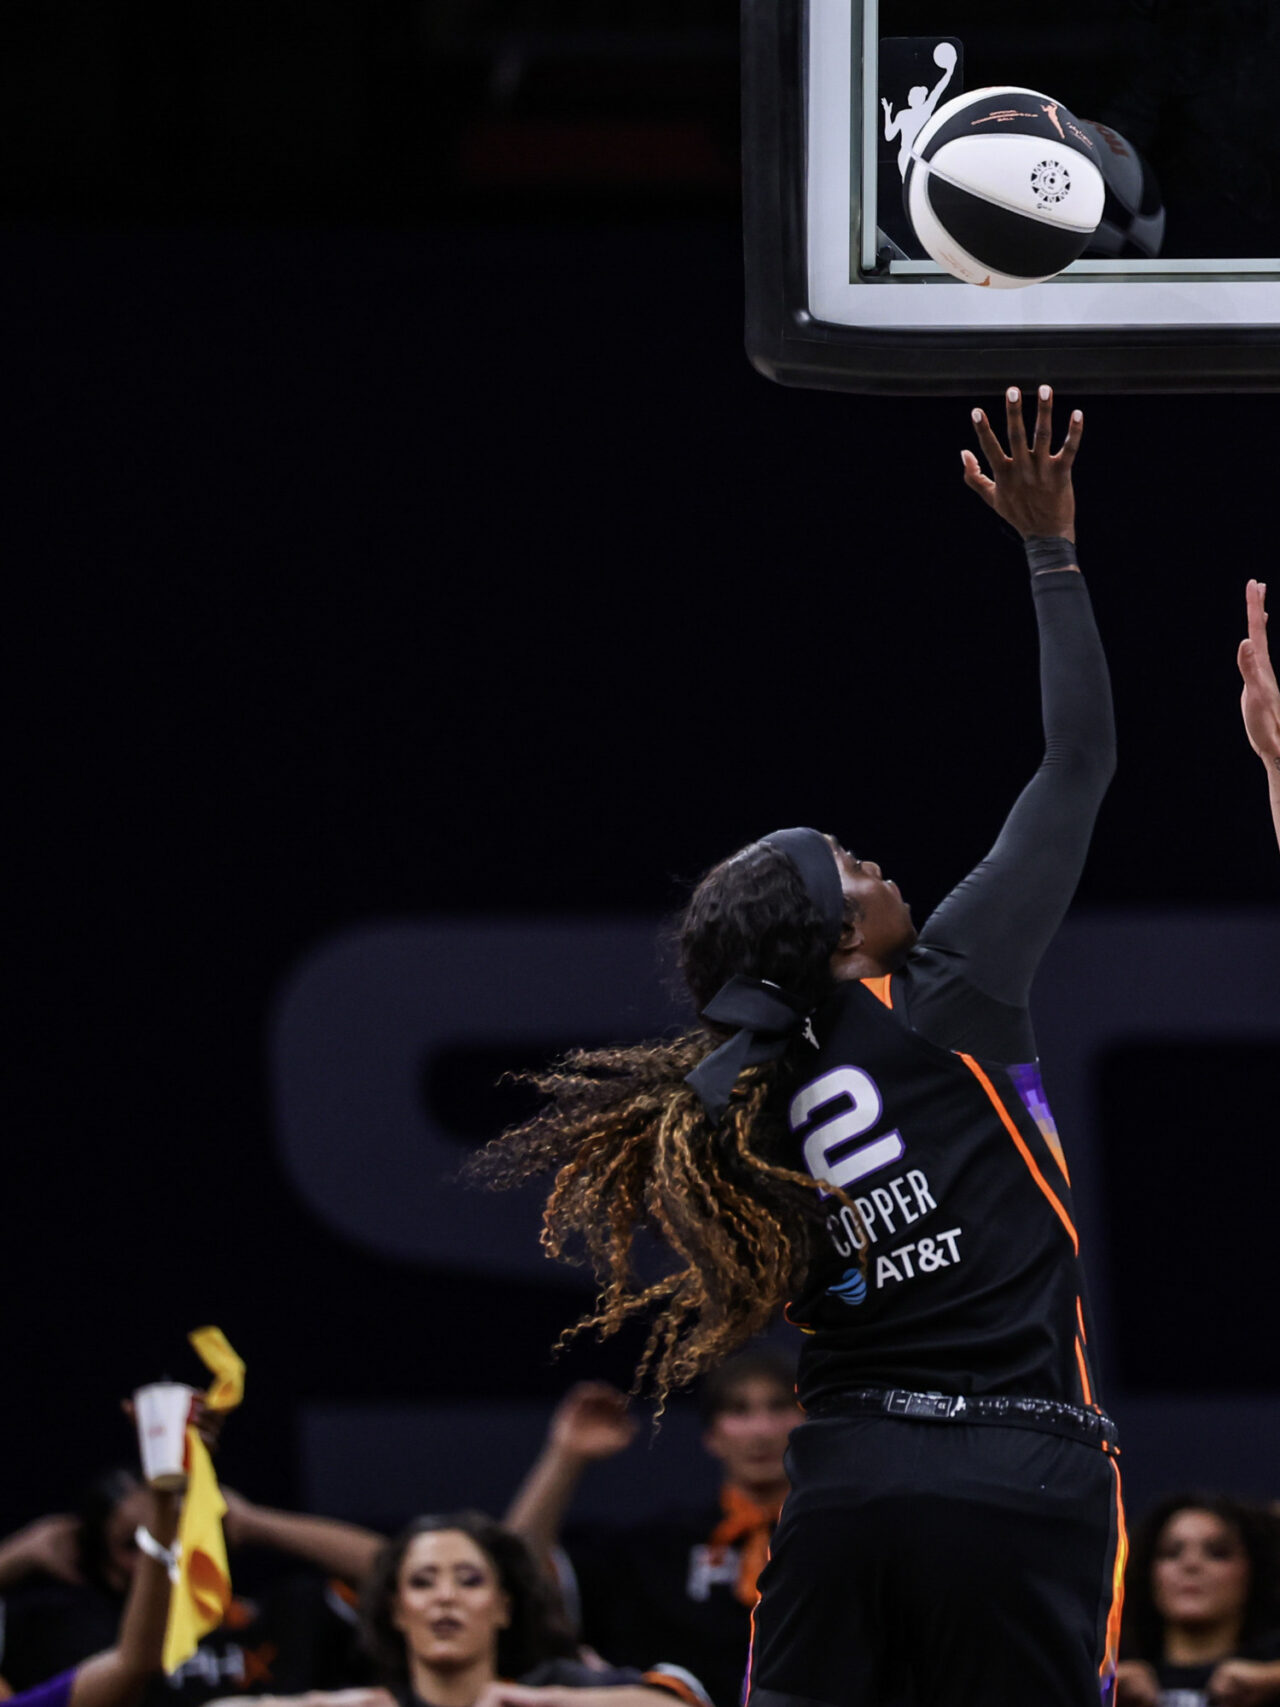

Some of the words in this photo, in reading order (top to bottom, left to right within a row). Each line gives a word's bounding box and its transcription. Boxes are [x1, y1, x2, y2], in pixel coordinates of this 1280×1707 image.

[789, 1064, 906, 1201] 2
[827, 1169, 938, 1258] COPPER
[876, 1227, 963, 1289] AT&T
